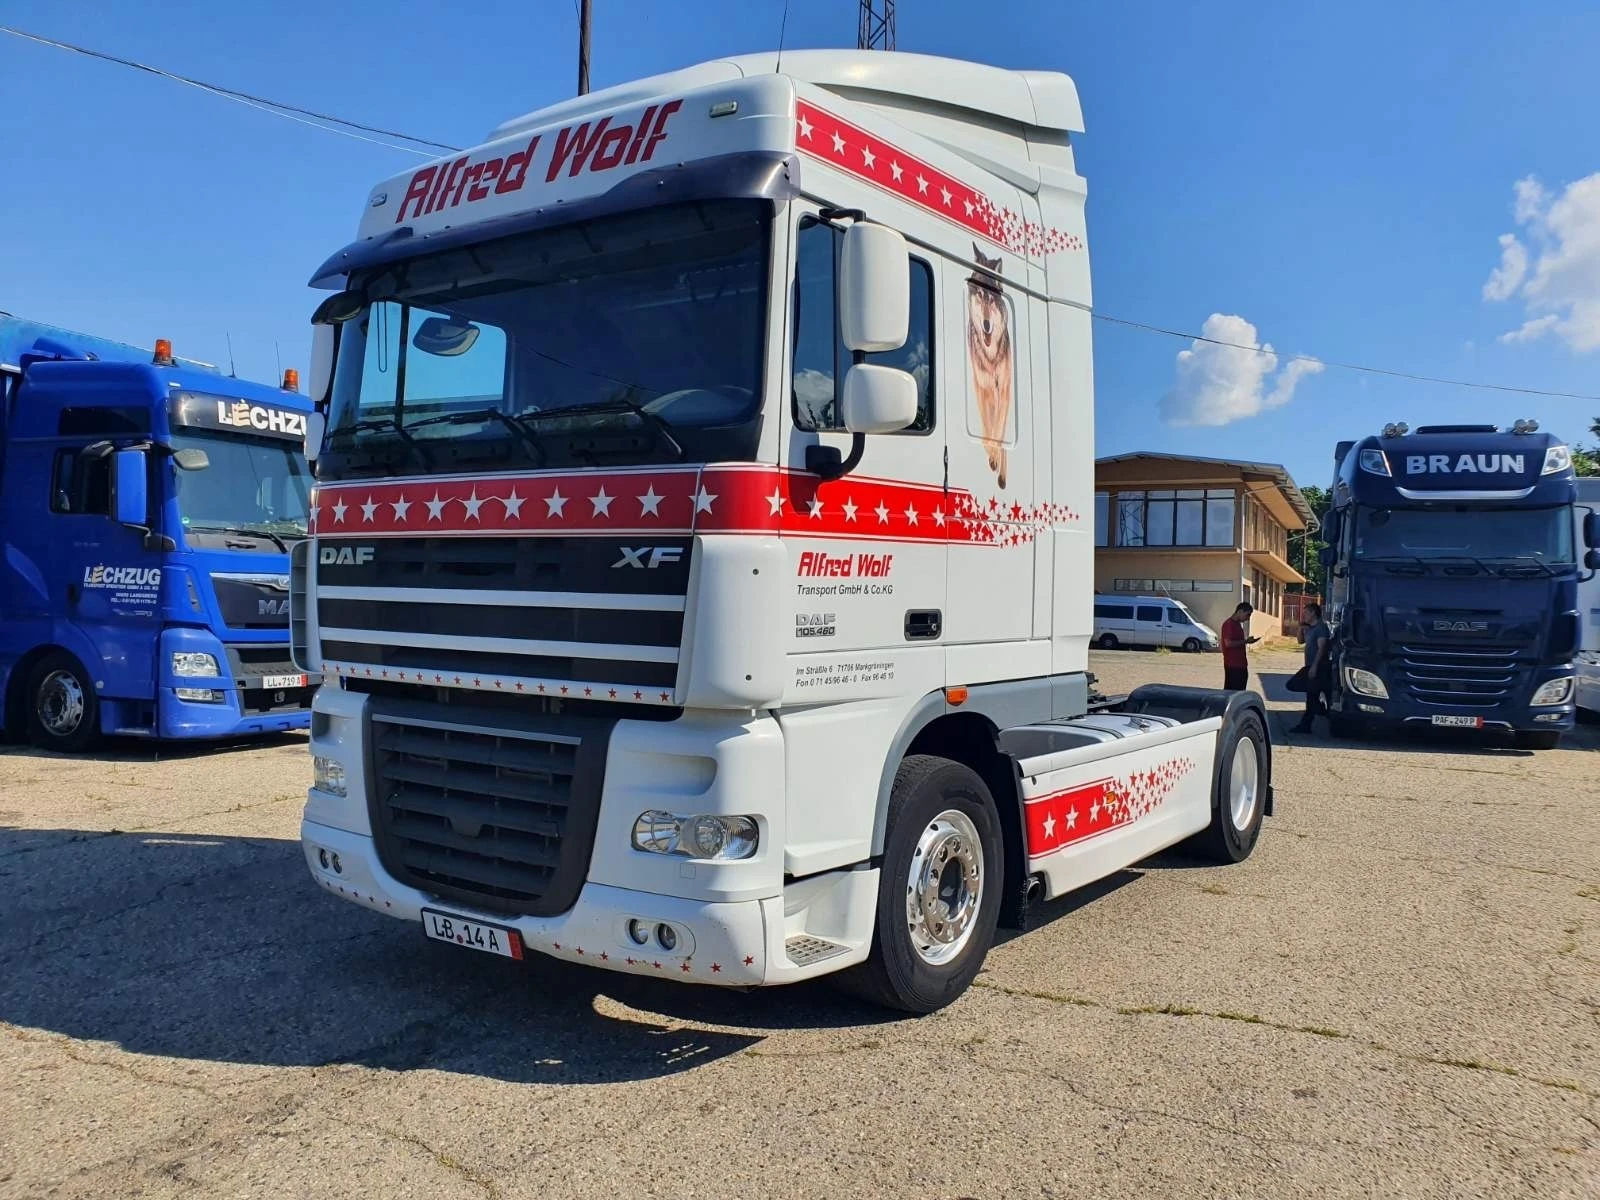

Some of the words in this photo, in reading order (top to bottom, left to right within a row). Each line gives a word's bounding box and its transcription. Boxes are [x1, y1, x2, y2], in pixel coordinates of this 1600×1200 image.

[396, 135, 542, 224] Alfred
[545, 98, 684, 183] Wolf
[1406, 454, 1525, 475] BRAUN
[320, 546, 375, 566] DAF
[610, 546, 684, 569] XF
[797, 551, 853, 577] Alfred
[857, 553, 893, 577] Wolf
[83, 564, 161, 585] LECHZUG
[797, 584, 837, 598] Transport
[838, 584, 862, 595] GmbH
[863, 584, 869, 595] &
[795, 613, 837, 626] DAF
[1432, 620, 1489, 632] DAF
[796, 626, 836, 637] 105.460
[795, 679, 809, 688] Fon
